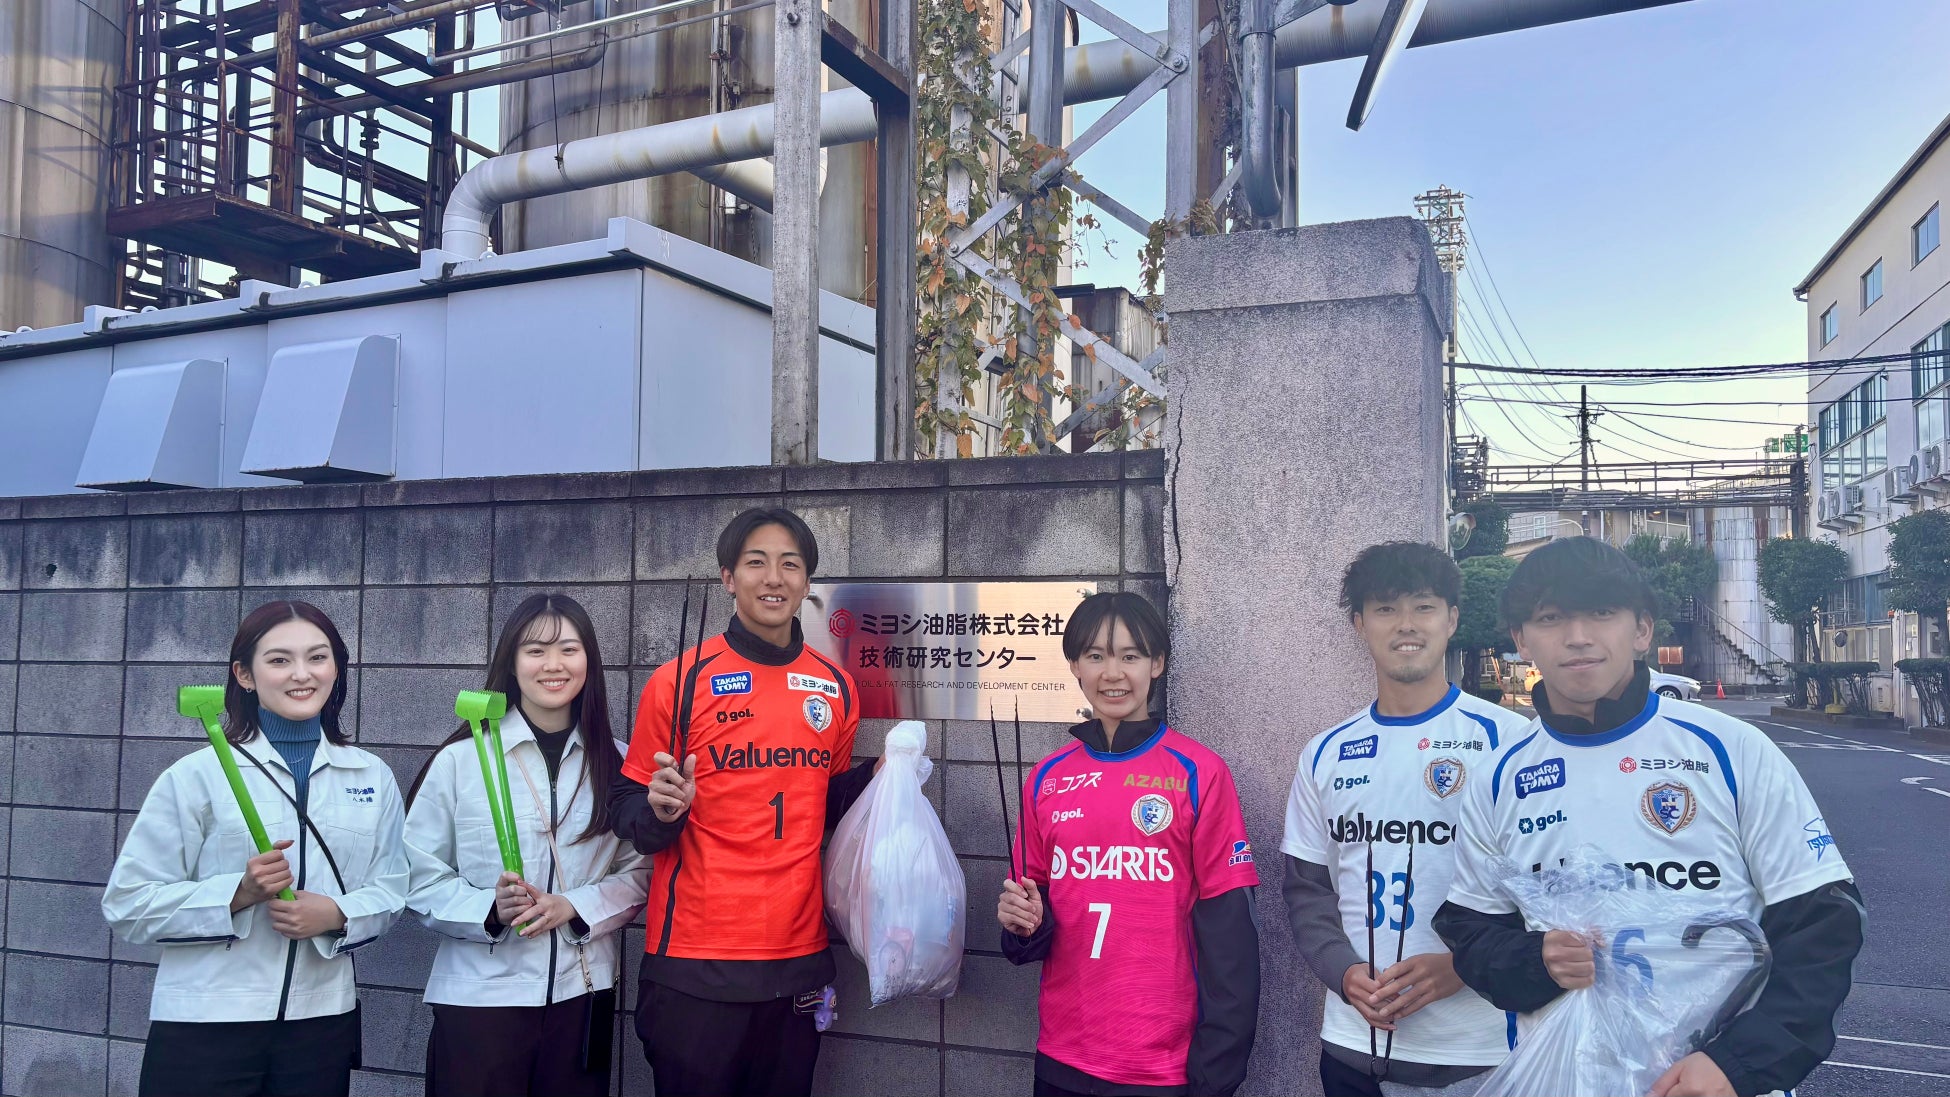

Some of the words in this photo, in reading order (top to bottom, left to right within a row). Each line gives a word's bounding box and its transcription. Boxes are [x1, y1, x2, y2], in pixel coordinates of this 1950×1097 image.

[860, 612, 1064, 636] ミヨシ油脂株式会社
[859, 646, 1037, 669] 技術研究センター
[714, 675, 748, 686] TAKARA
[715, 682, 748, 692] TOMY
[861, 680, 874, 689] OIL
[876, 680, 882, 688] &
[885, 680, 899, 689] FAT
[901, 680, 944, 689] RESEARCH
[946, 681, 965, 689] AND
[967, 682, 1028, 690] DEVELOPMENT
[1031, 683, 1066, 691] CENTER
[729, 708, 754, 721] gol.
[1432, 740, 1484, 752] ミヨシ油脂
[708, 742, 831, 769] Valuence
[1640, 758, 1709, 774] ミヨシ油脂
[1123, 773, 1188, 792] AZABU
[1345, 774, 1371, 789] gol.
[768, 792, 784, 839] 1
[1060, 807, 1084, 822] gol.
[1536, 809, 1568, 832] gol.
[1328, 812, 1457, 844] Valuenc
[1088, 902, 1112, 959] 7
